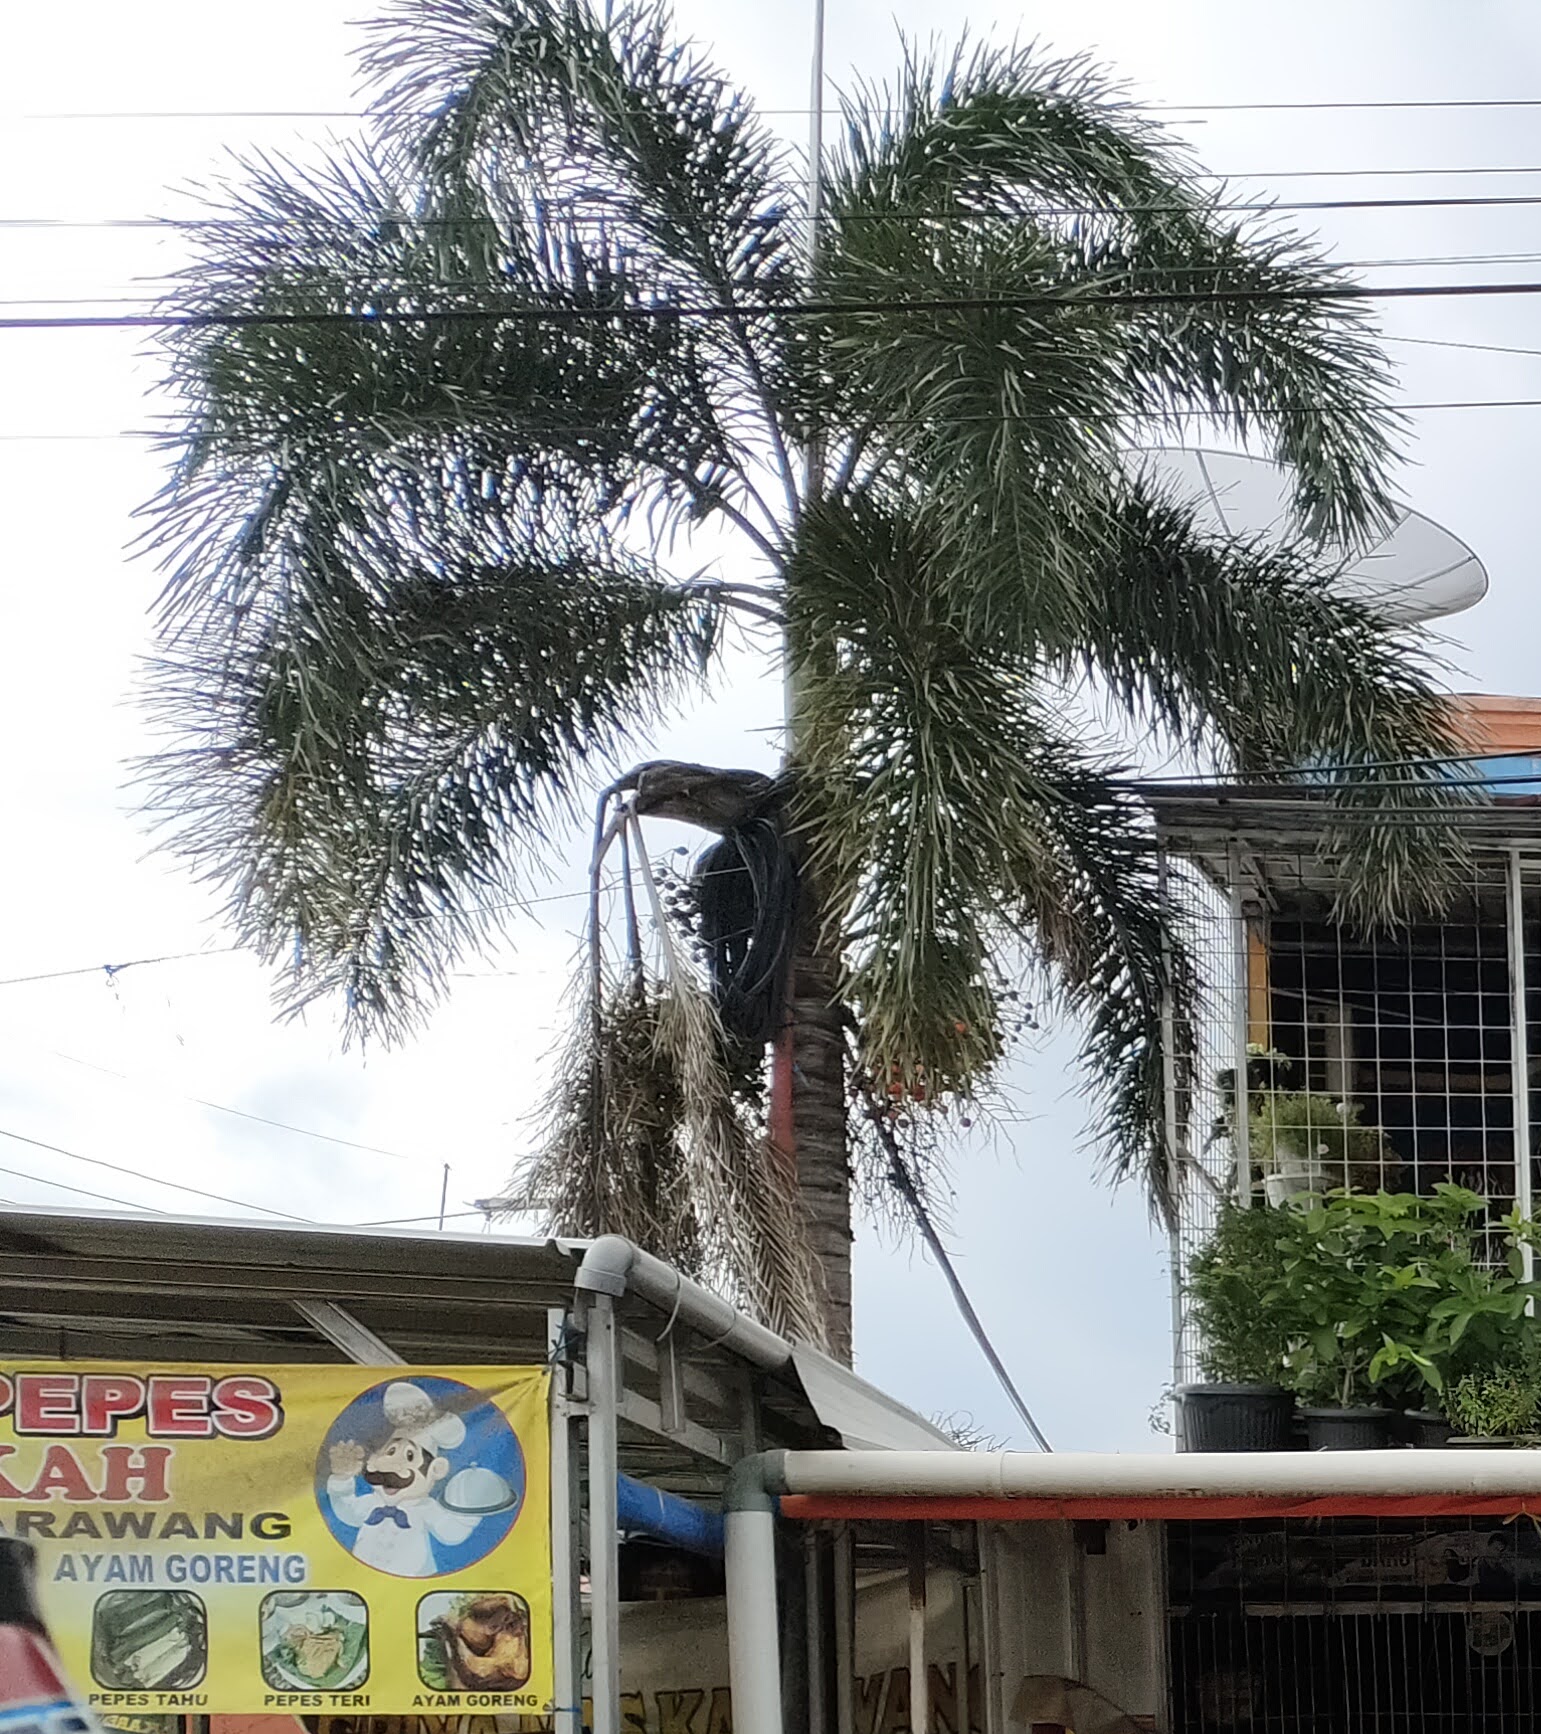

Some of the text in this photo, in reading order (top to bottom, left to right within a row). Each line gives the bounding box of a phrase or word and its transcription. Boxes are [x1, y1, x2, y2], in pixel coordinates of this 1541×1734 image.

[0, 1374, 283, 1440] EPES
[0, 1510, 292, 1541] RAWANG
[53, 1552, 307, 1585] AYAM GORENG
[87, 1692, 208, 1706] PEPES TAHU
[263, 1694, 371, 1707] PEPES TERI
[412, 1694, 538, 1707] AYAM GORENG
